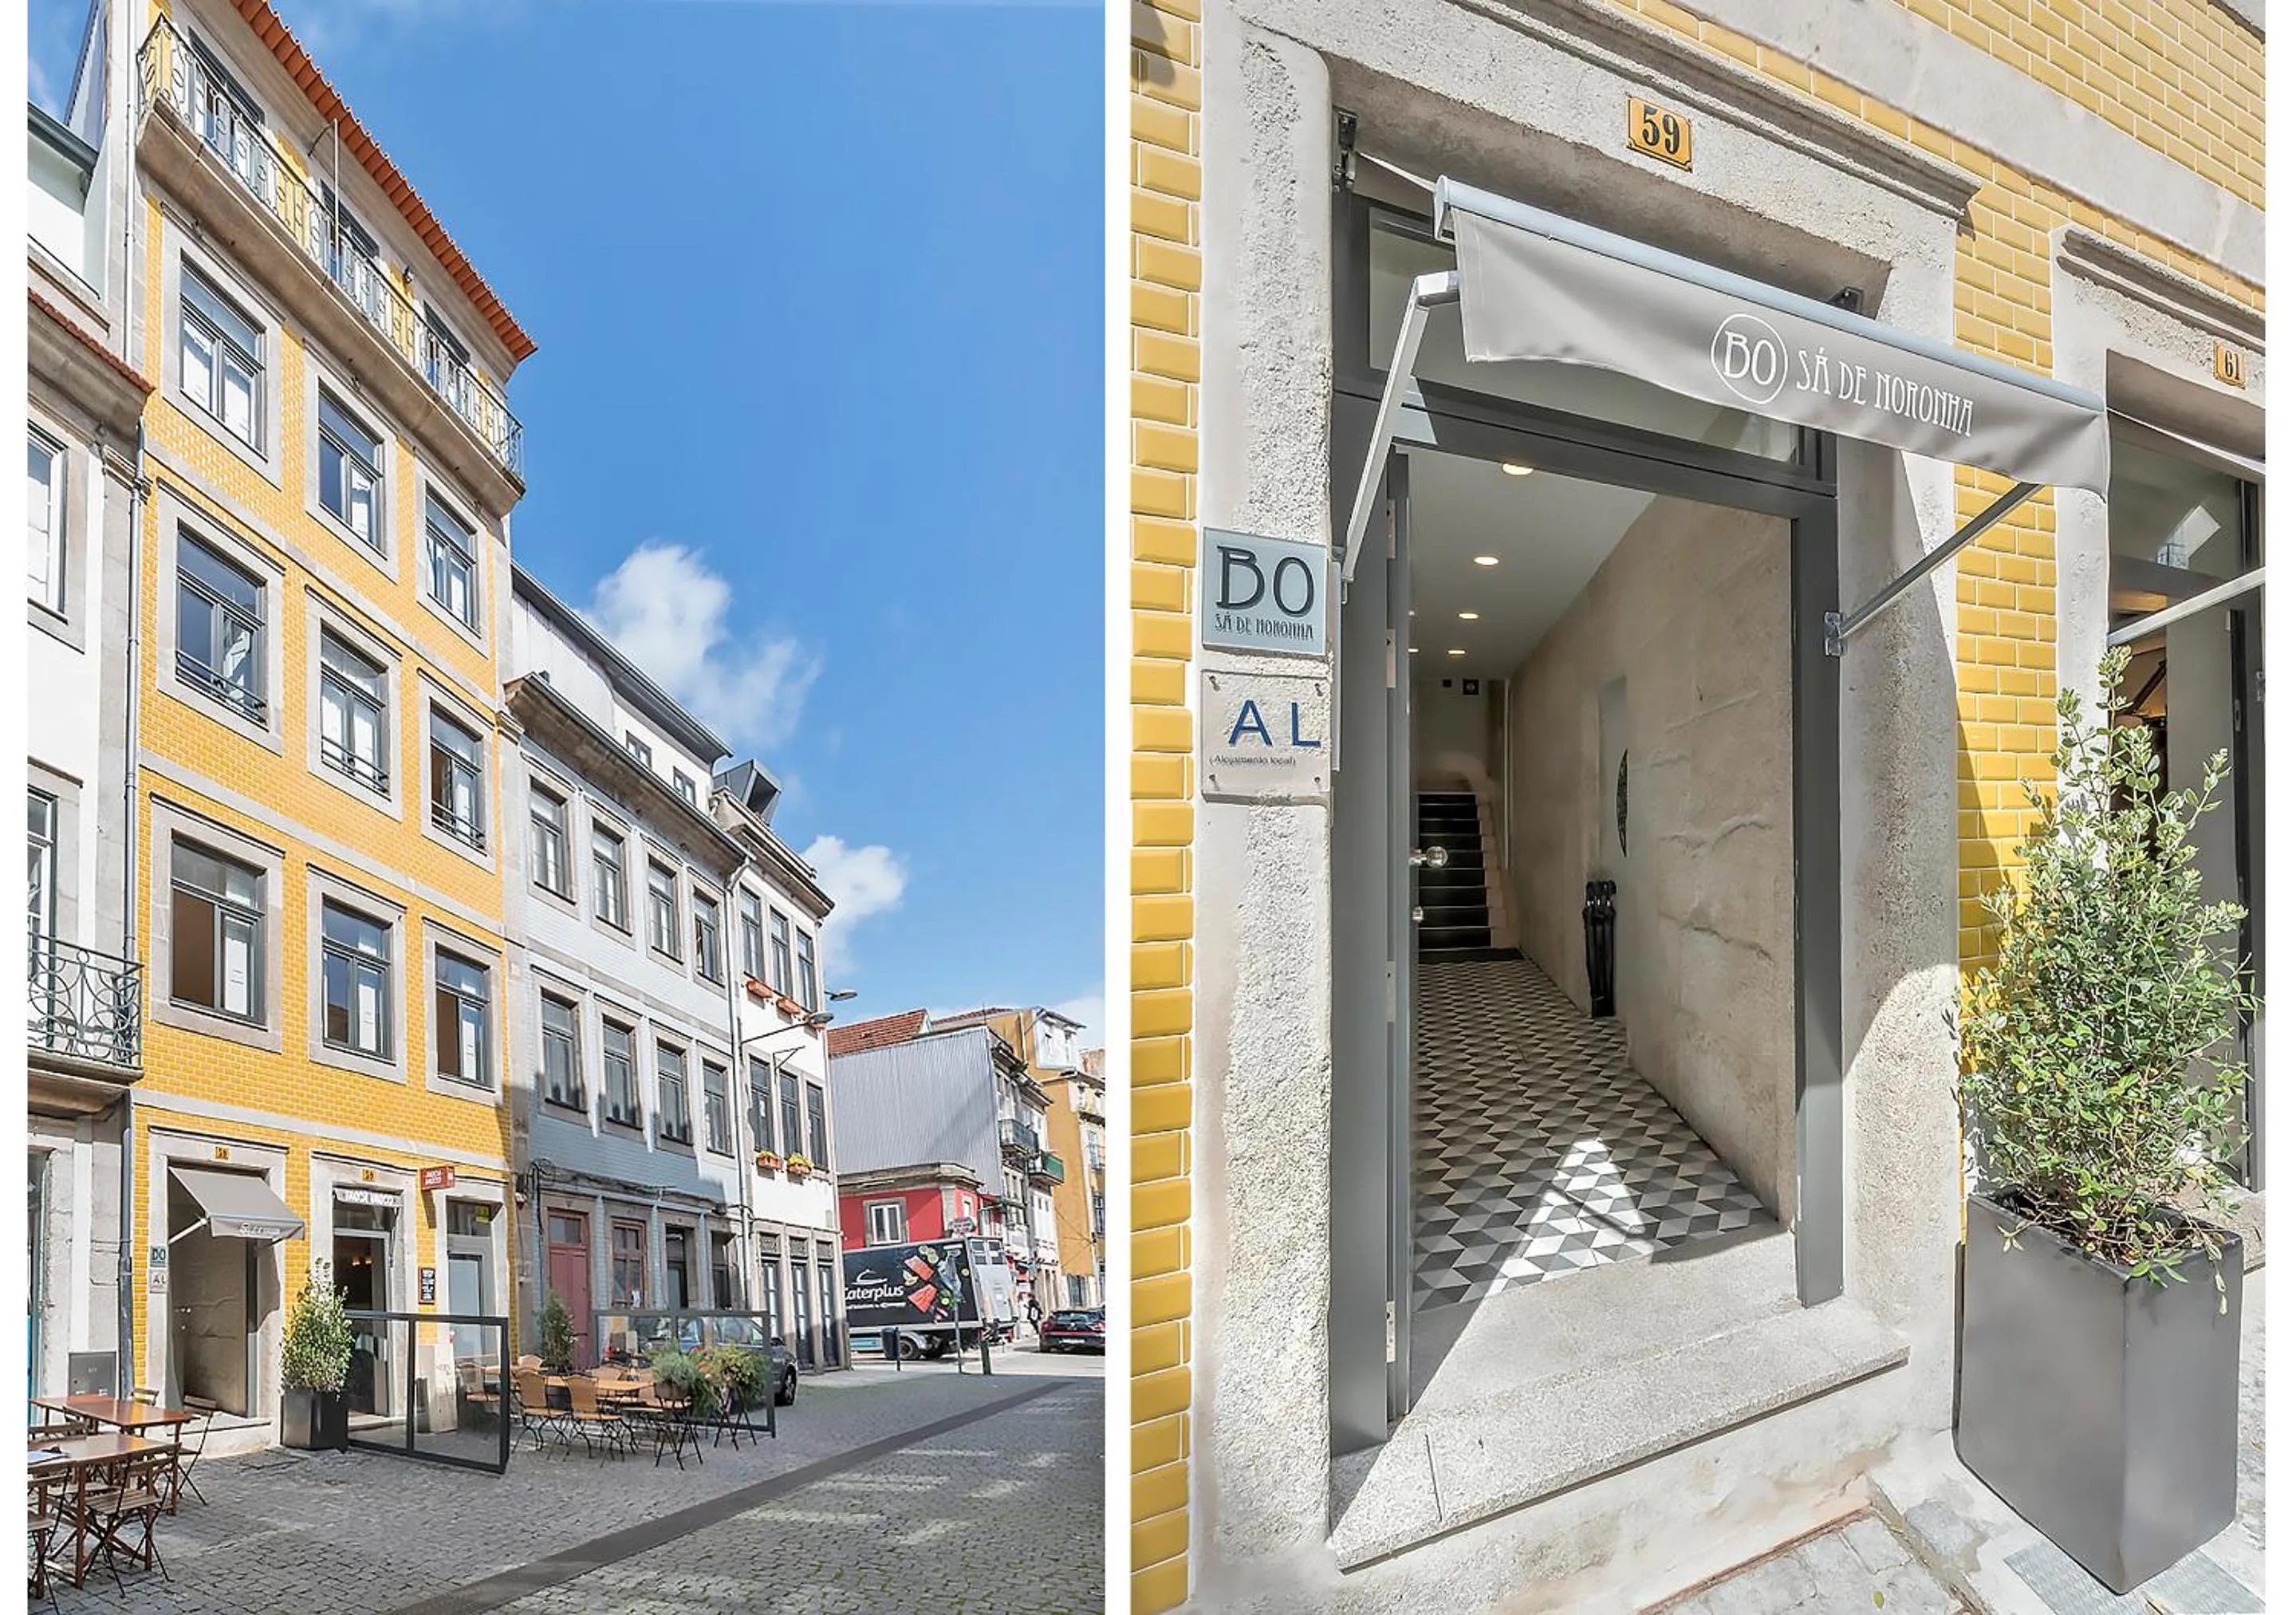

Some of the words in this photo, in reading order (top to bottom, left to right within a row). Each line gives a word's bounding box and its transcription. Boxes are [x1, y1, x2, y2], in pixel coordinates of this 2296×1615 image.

[1643, 104, 1680, 154] 59
[1723, 330, 1778, 386] BO
[1796, 347, 1832, 395] SÁ
[1838, 360, 1868, 406] DE
[1873, 370, 1975, 437] NORONHA
[2224, 349, 2240, 380] 61
[1215, 545, 1315, 617] BO
[1236, 616, 1253, 635] DE
